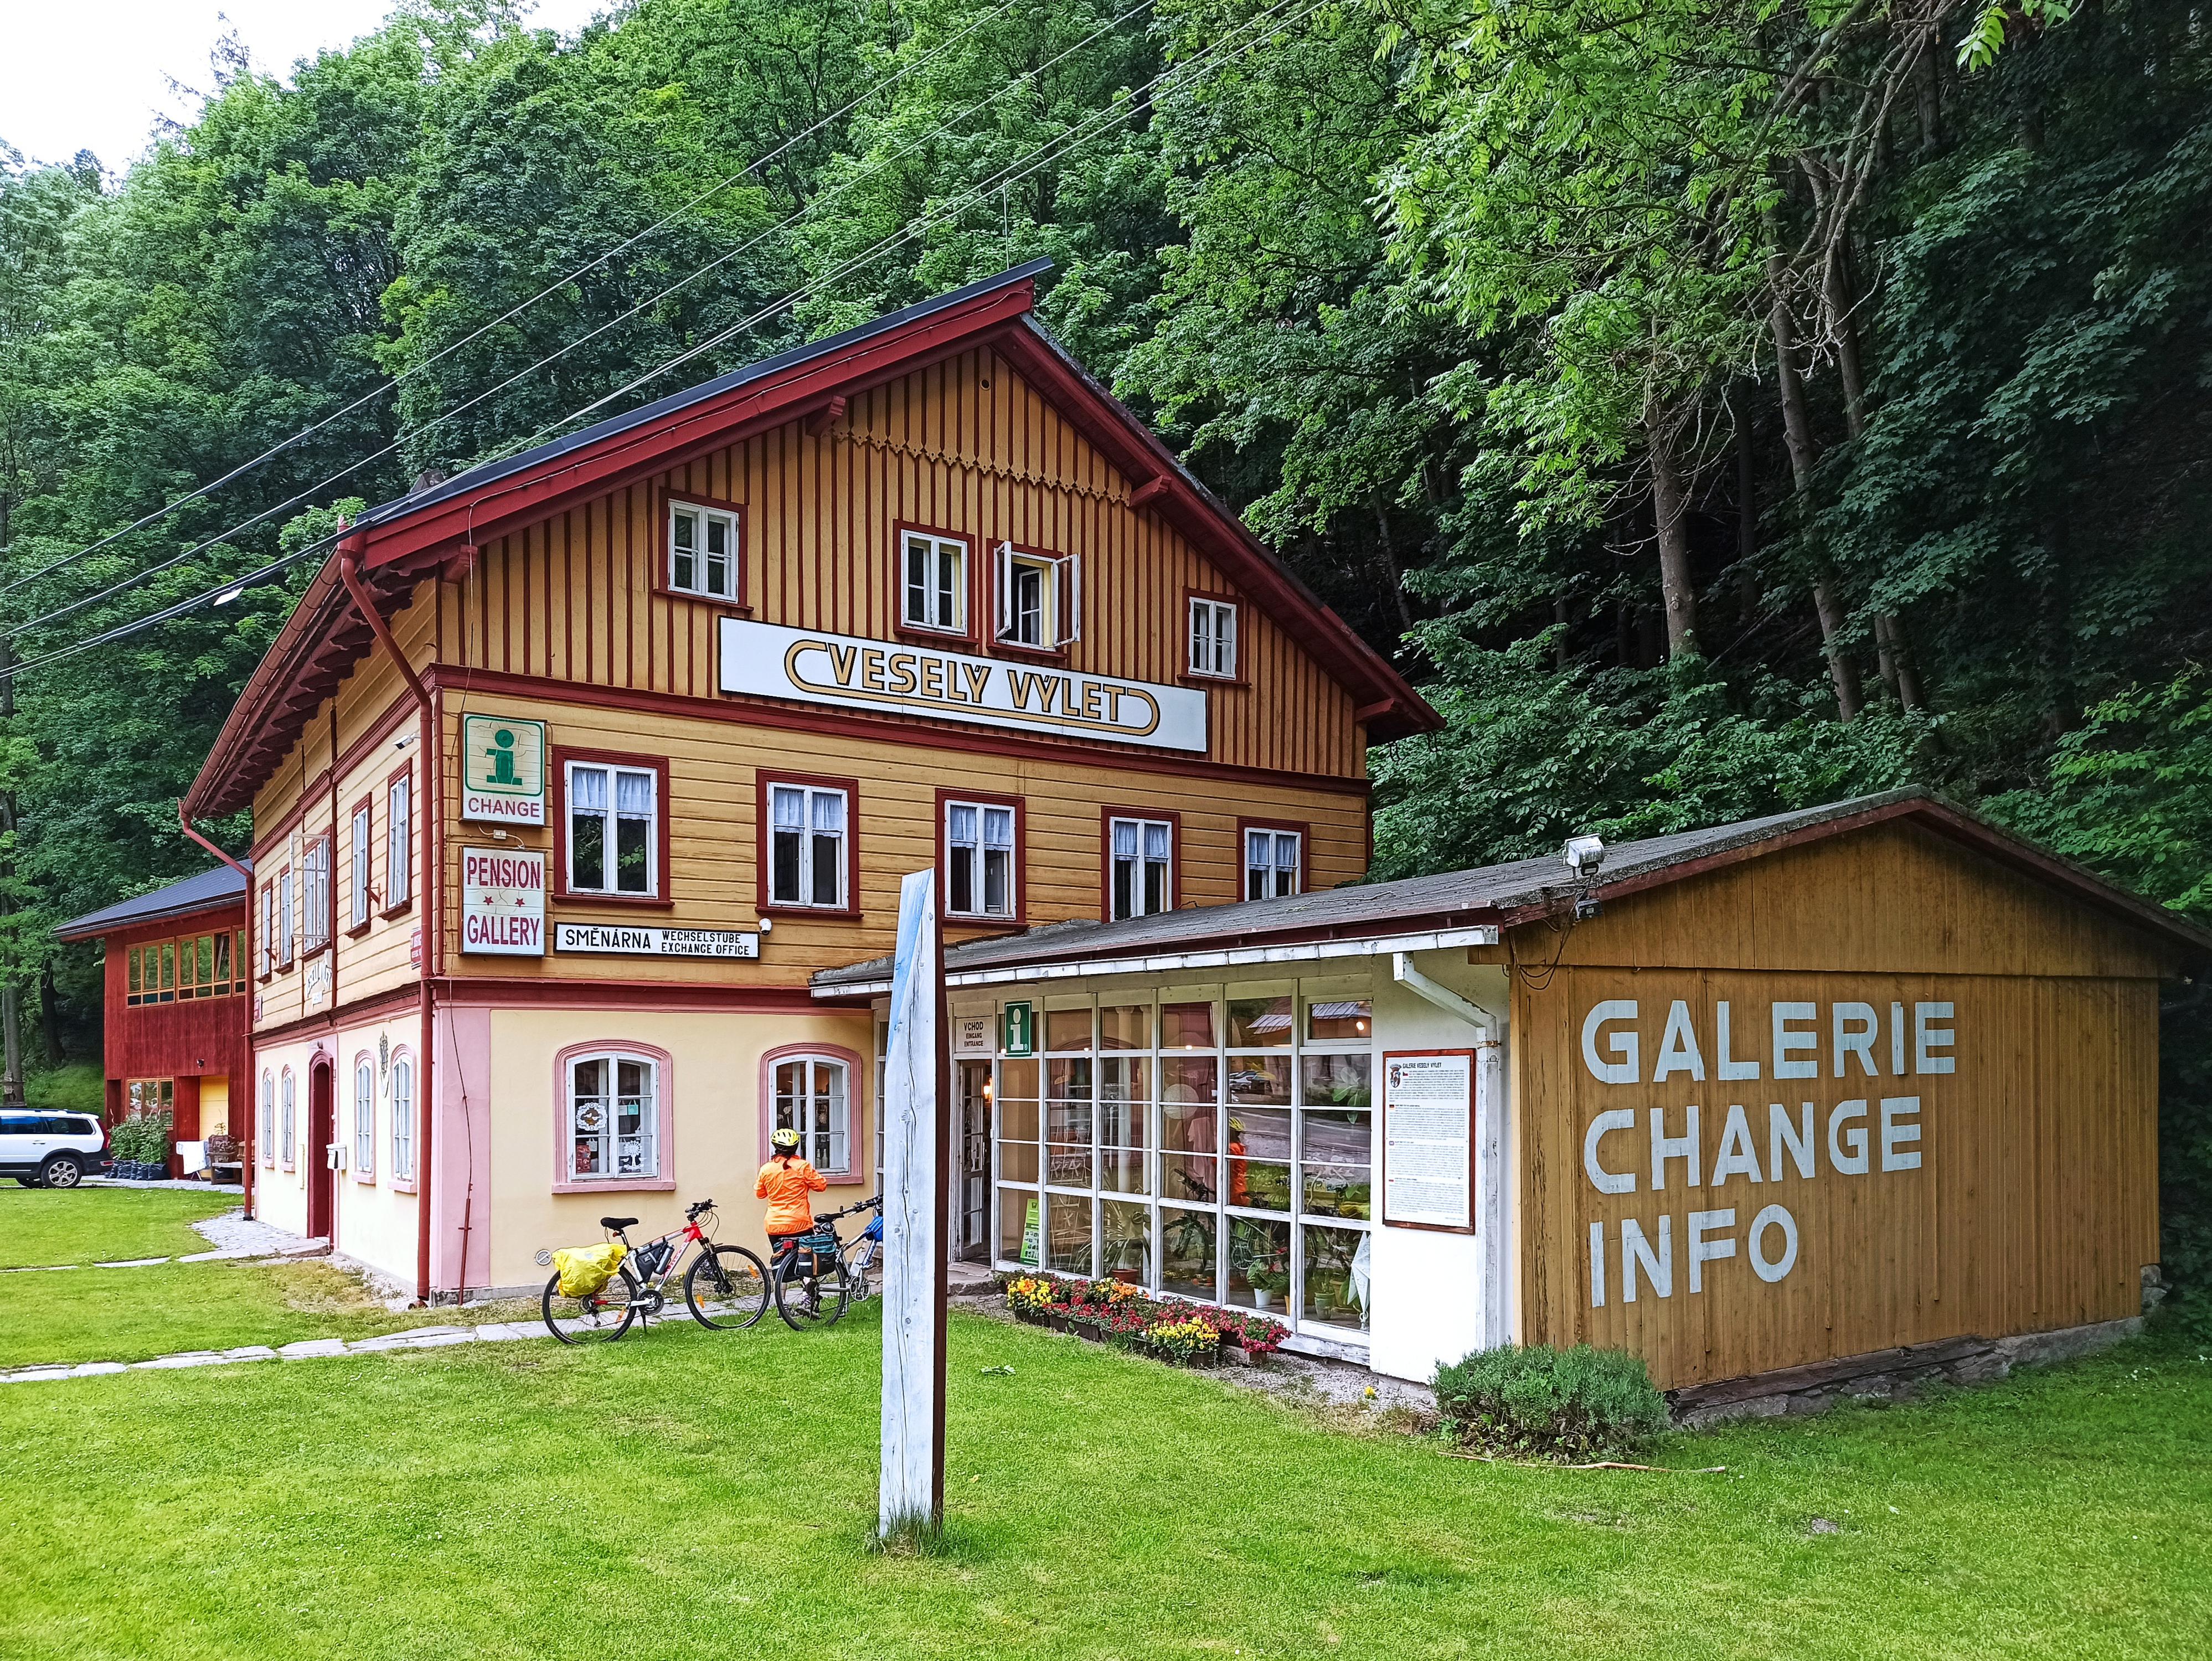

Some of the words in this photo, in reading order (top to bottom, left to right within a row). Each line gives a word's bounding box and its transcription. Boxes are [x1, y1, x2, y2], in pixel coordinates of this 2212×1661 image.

[828, 643, 992, 703] VESELÝ
[1008, 669, 1126, 723] VÝLET
[468, 797, 540, 818] CHANGE
[467, 857, 540, 889] PENSION
[467, 914, 540, 947] GALLERY
[565, 927, 651, 950] SMĚNÁRNA
[662, 930, 741, 944] WECHSELSTUBE
[661, 942, 713, 955] EXCHANGE
[715, 944, 750, 956] OFFICE
[963, 1021, 984, 1031] VCHOD
[1581, 999, 1955, 1084] GALERIE
[1584, 1096, 1922, 1194] CHANGE
[1590, 1204, 1798, 1308] INFO
